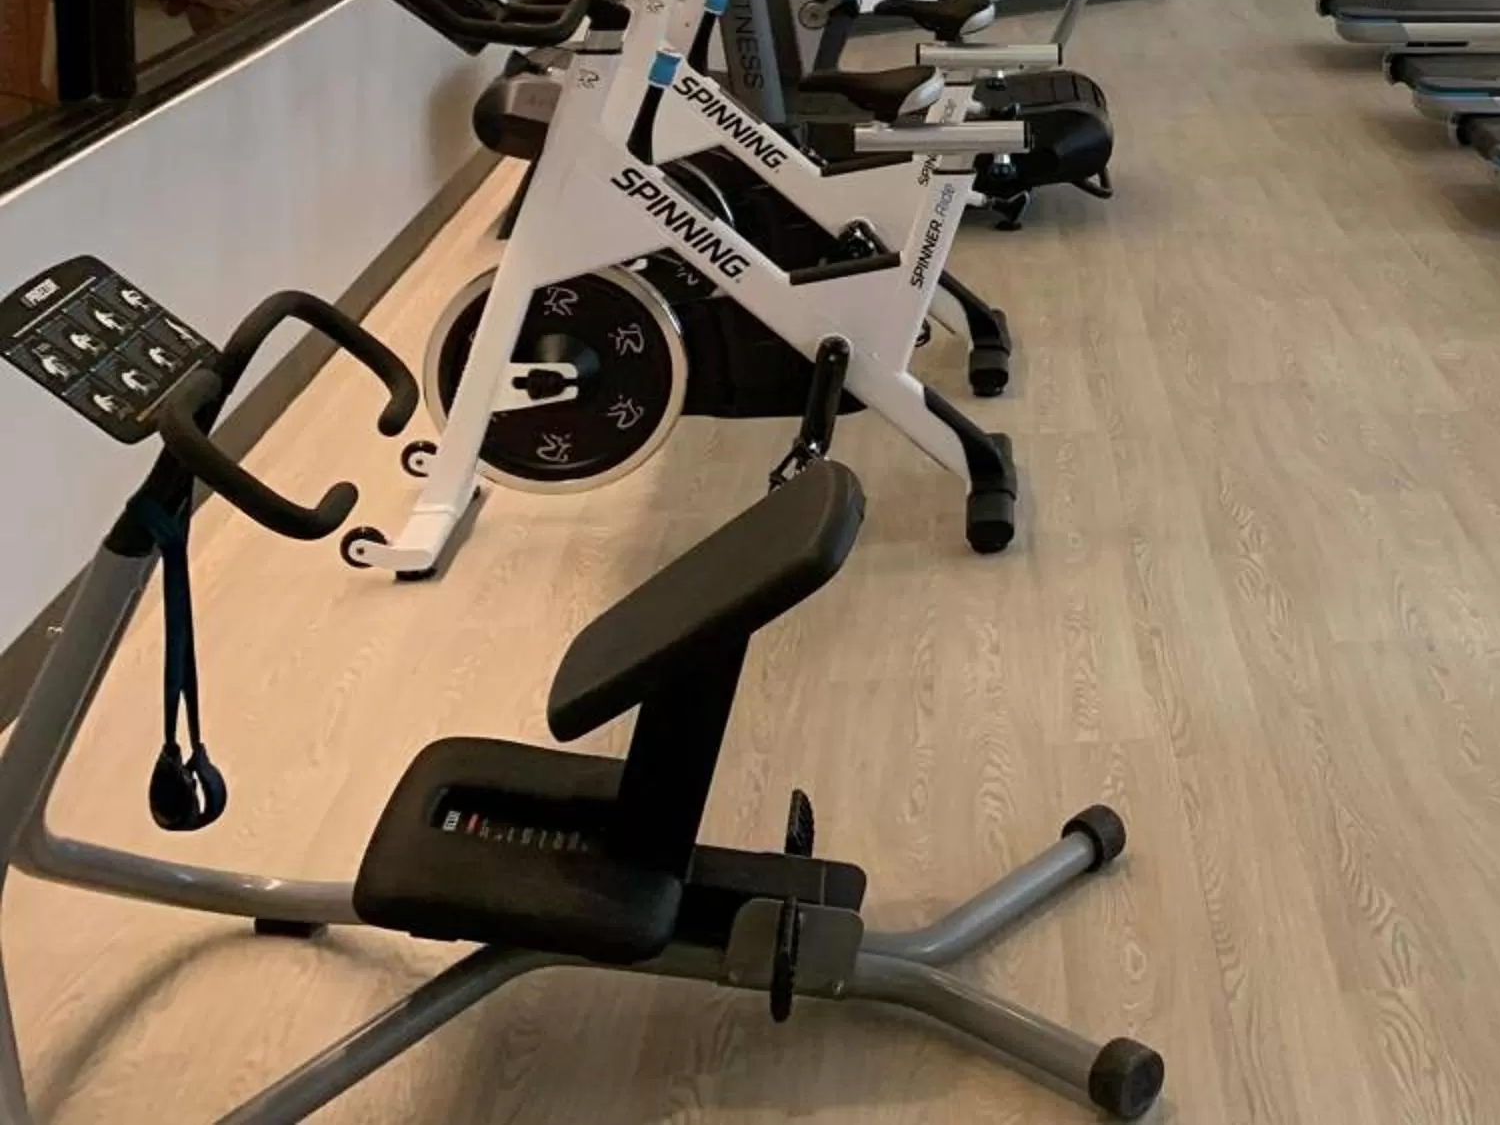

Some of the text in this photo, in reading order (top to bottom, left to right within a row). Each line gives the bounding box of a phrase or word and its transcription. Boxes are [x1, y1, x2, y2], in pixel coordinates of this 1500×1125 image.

[674, 76, 788, 172] SPINNING
[611, 167, 749, 283] SPINNING
[911, 219, 943, 290] SPINNER
